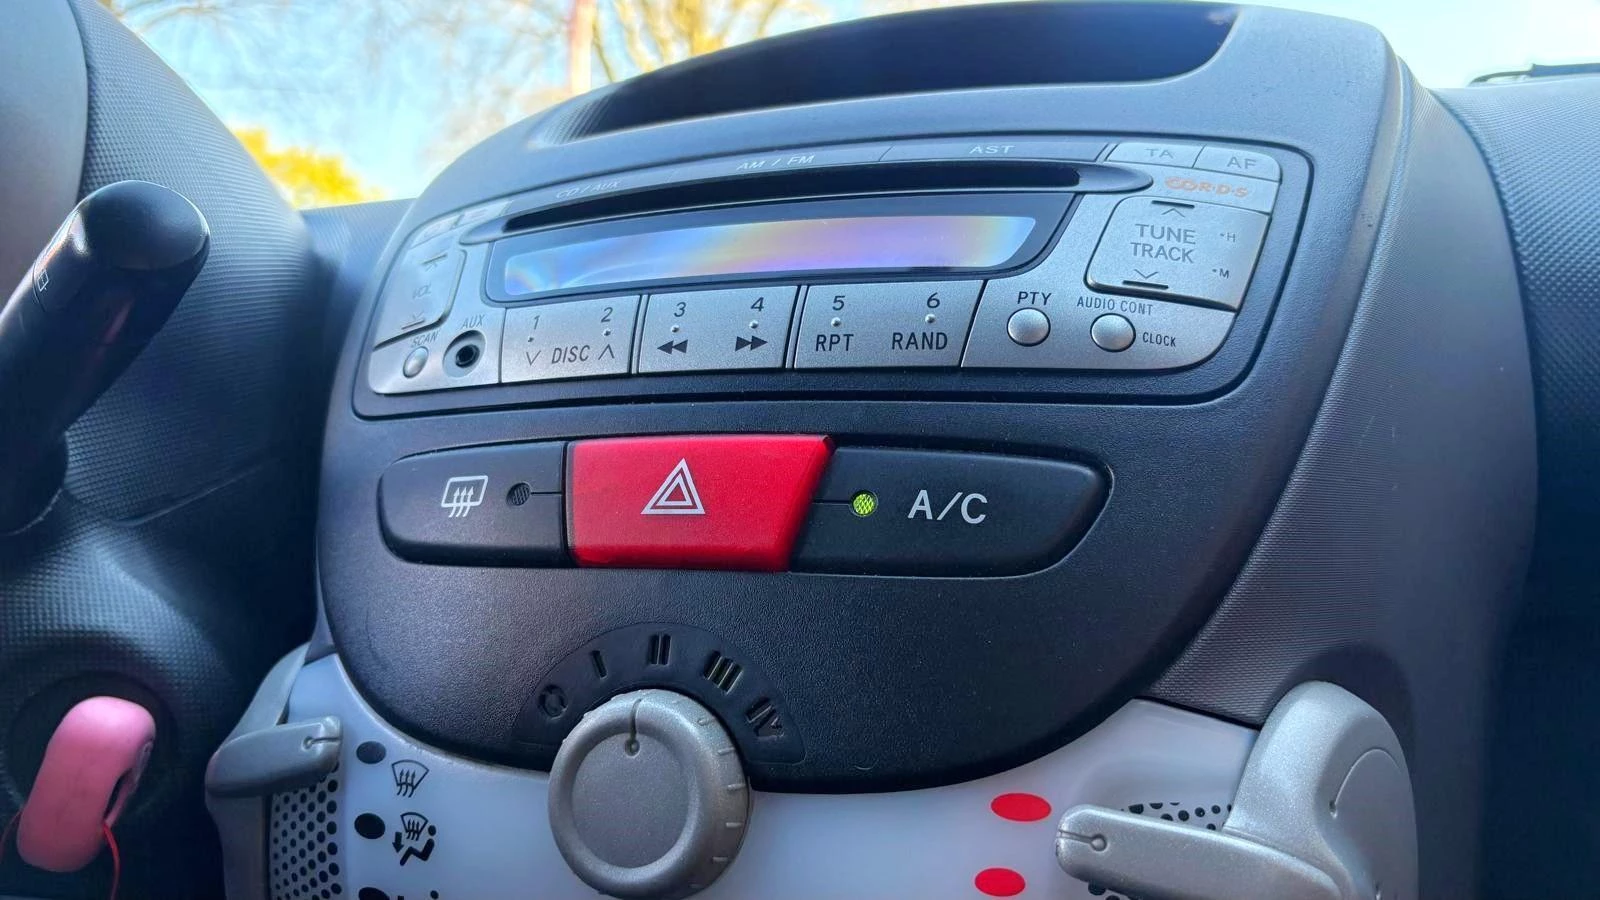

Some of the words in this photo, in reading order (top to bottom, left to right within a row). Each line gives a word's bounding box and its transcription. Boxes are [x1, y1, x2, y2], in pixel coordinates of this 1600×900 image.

[969, 145, 1014, 155] AST
[1146, 147, 1175, 160] TA
[736, 160, 764, 171] AM
[787, 155, 815, 166] FM
[1226, 156, 1257, 170] AF
[1135, 223, 1196, 246] TUNE
[1129, 241, 1195, 264] TRACK
[412, 282, 432, 300] VOL
[1017, 291, 1052, 306] PTY
[750, 297, 764, 312] 4
[832, 295, 846, 311] 5
[926, 292, 941, 309] 6
[1076, 296, 1116, 312] AUDIO
[1120, 301, 1154, 317] CONT
[601, 307, 613, 323] 2
[673, 302, 687, 318] 3
[460, 314, 485, 329] AUX
[533, 315, 541, 331] 1
[411, 330, 440, 347] SCAN
[815, 333, 854, 352] RPT
[891, 331, 948, 351] RAND
[1142, 331, 1177, 348] CLOCK
[551, 345, 590, 365] DISC
[907, 489, 988, 524] A/C
